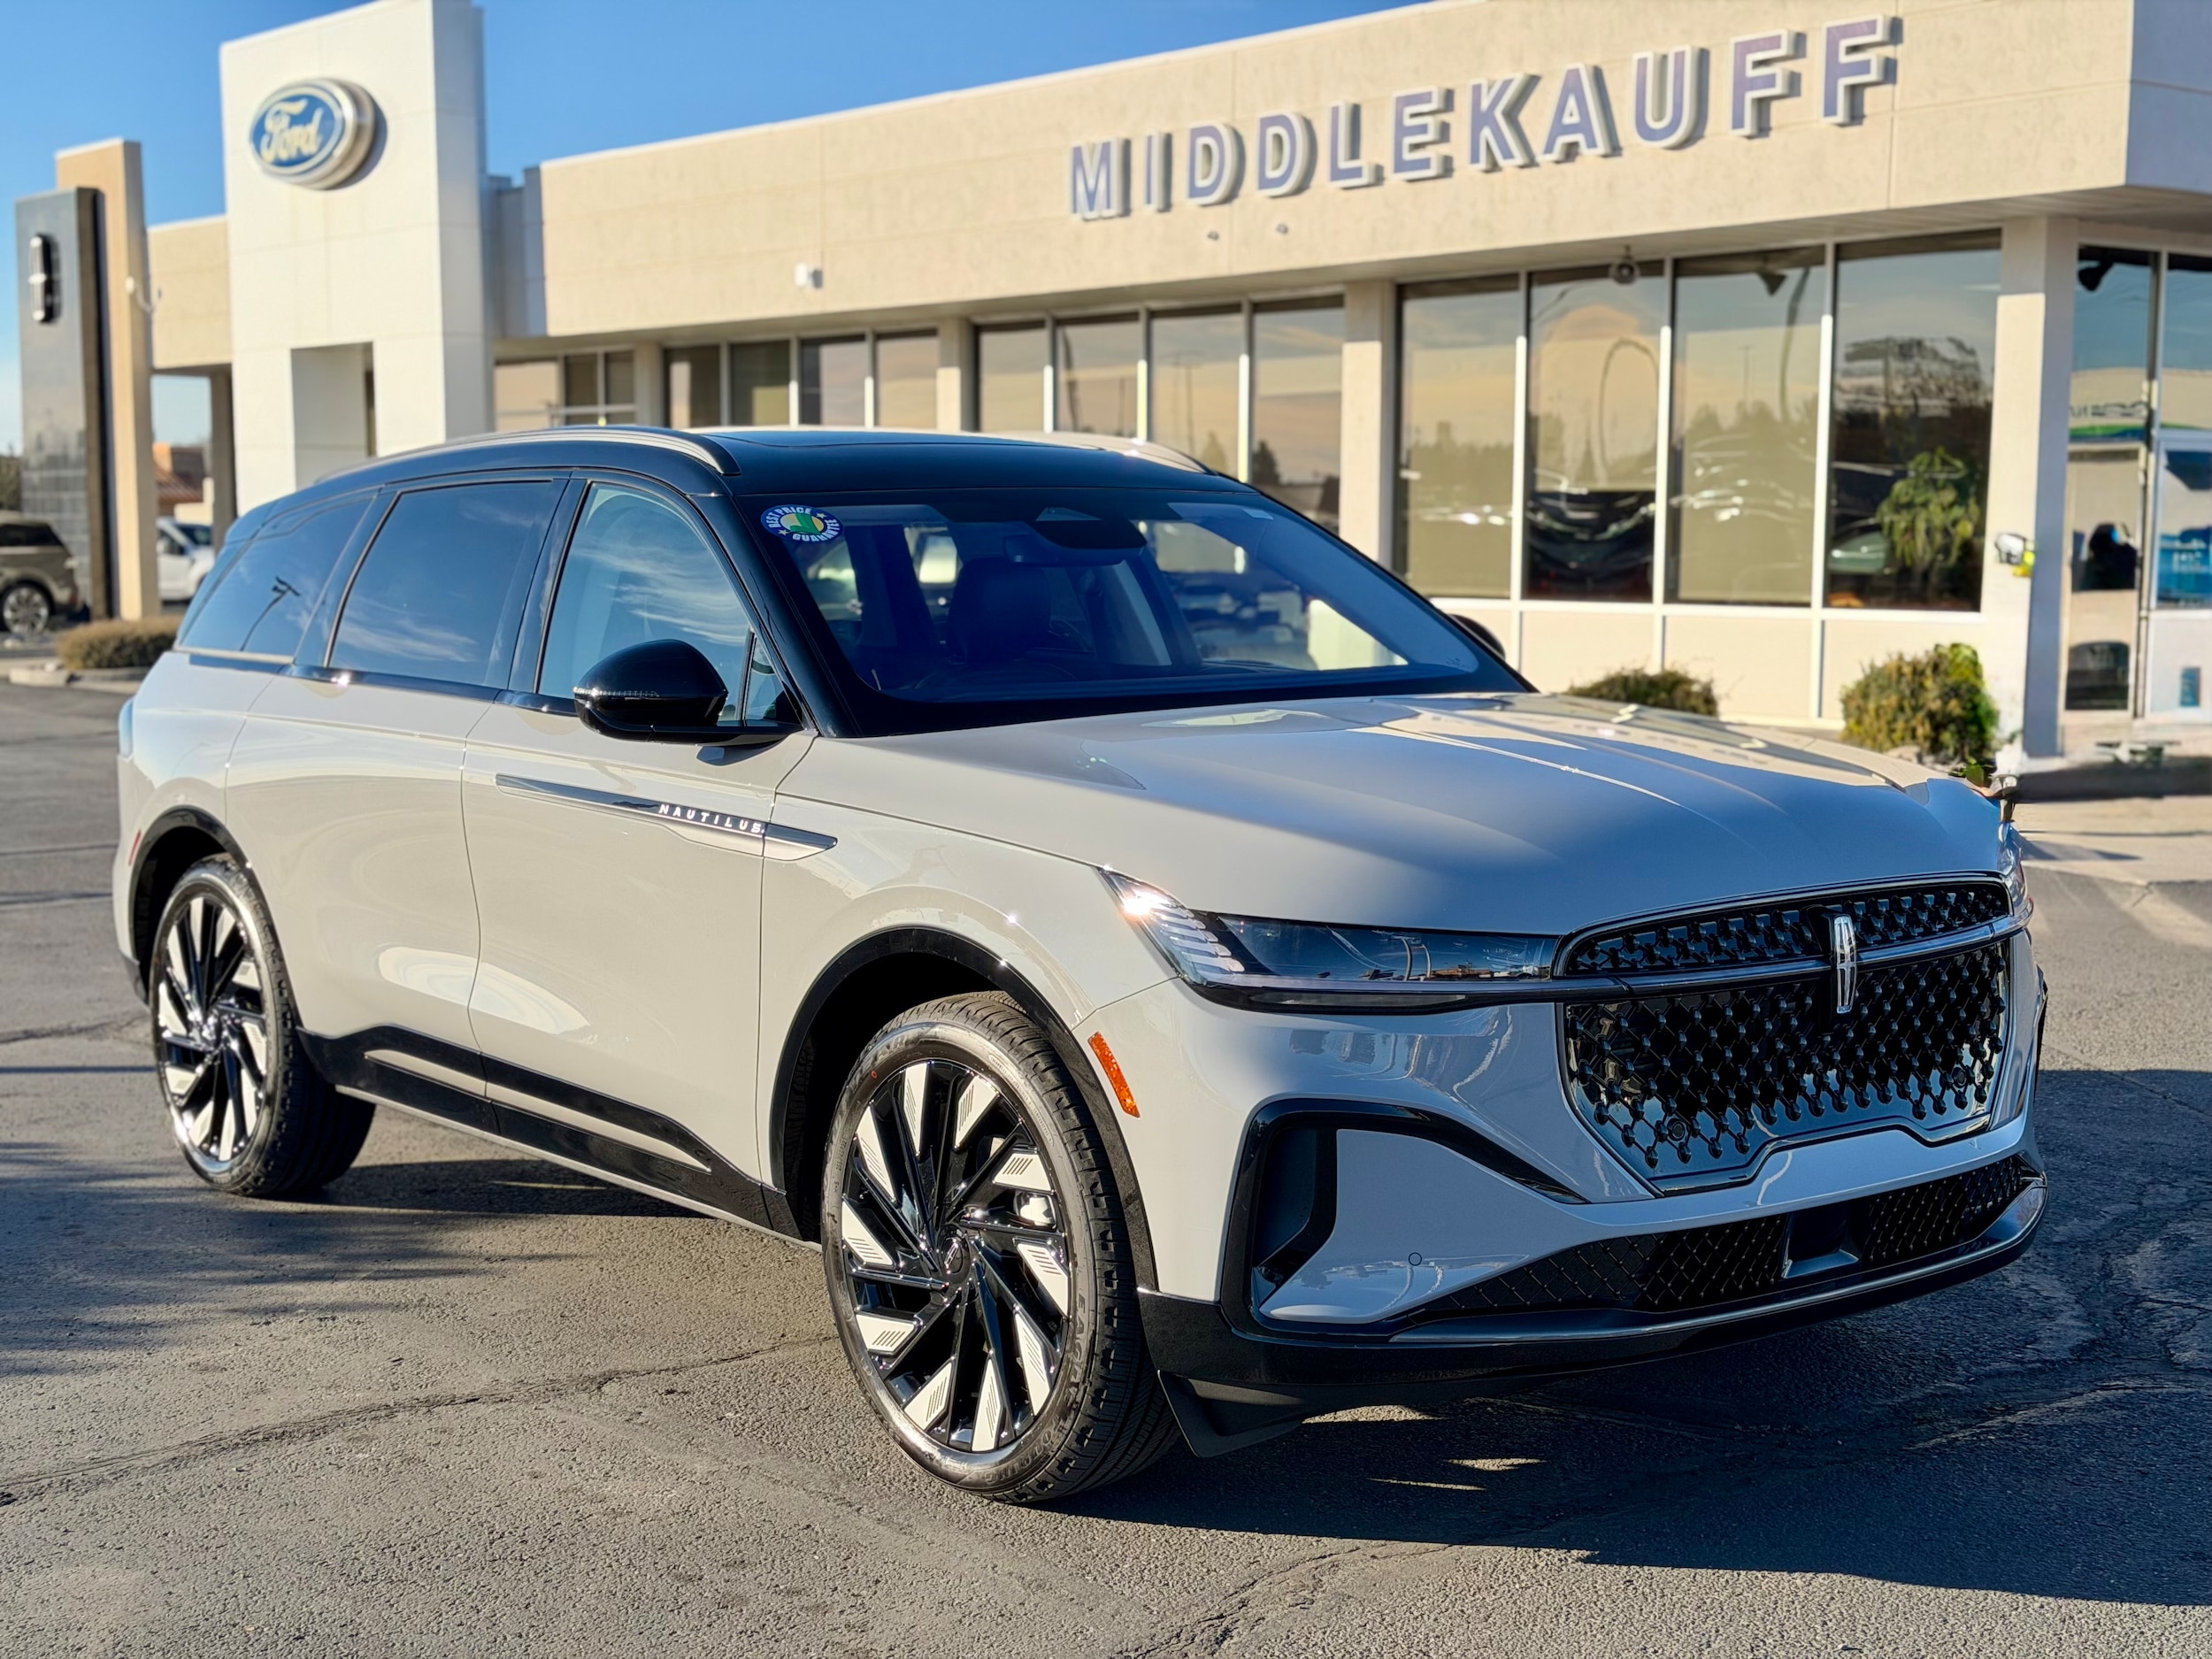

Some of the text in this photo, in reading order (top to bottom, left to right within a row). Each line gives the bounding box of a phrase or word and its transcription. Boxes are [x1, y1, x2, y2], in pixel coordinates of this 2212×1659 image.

[260, 97, 324, 163] Ford
[1069, 13, 1899, 221] MIDDLEKAUFF
[765, 506, 812, 528] BEST PRICE
[658, 803, 763, 833] NAUTILUS
